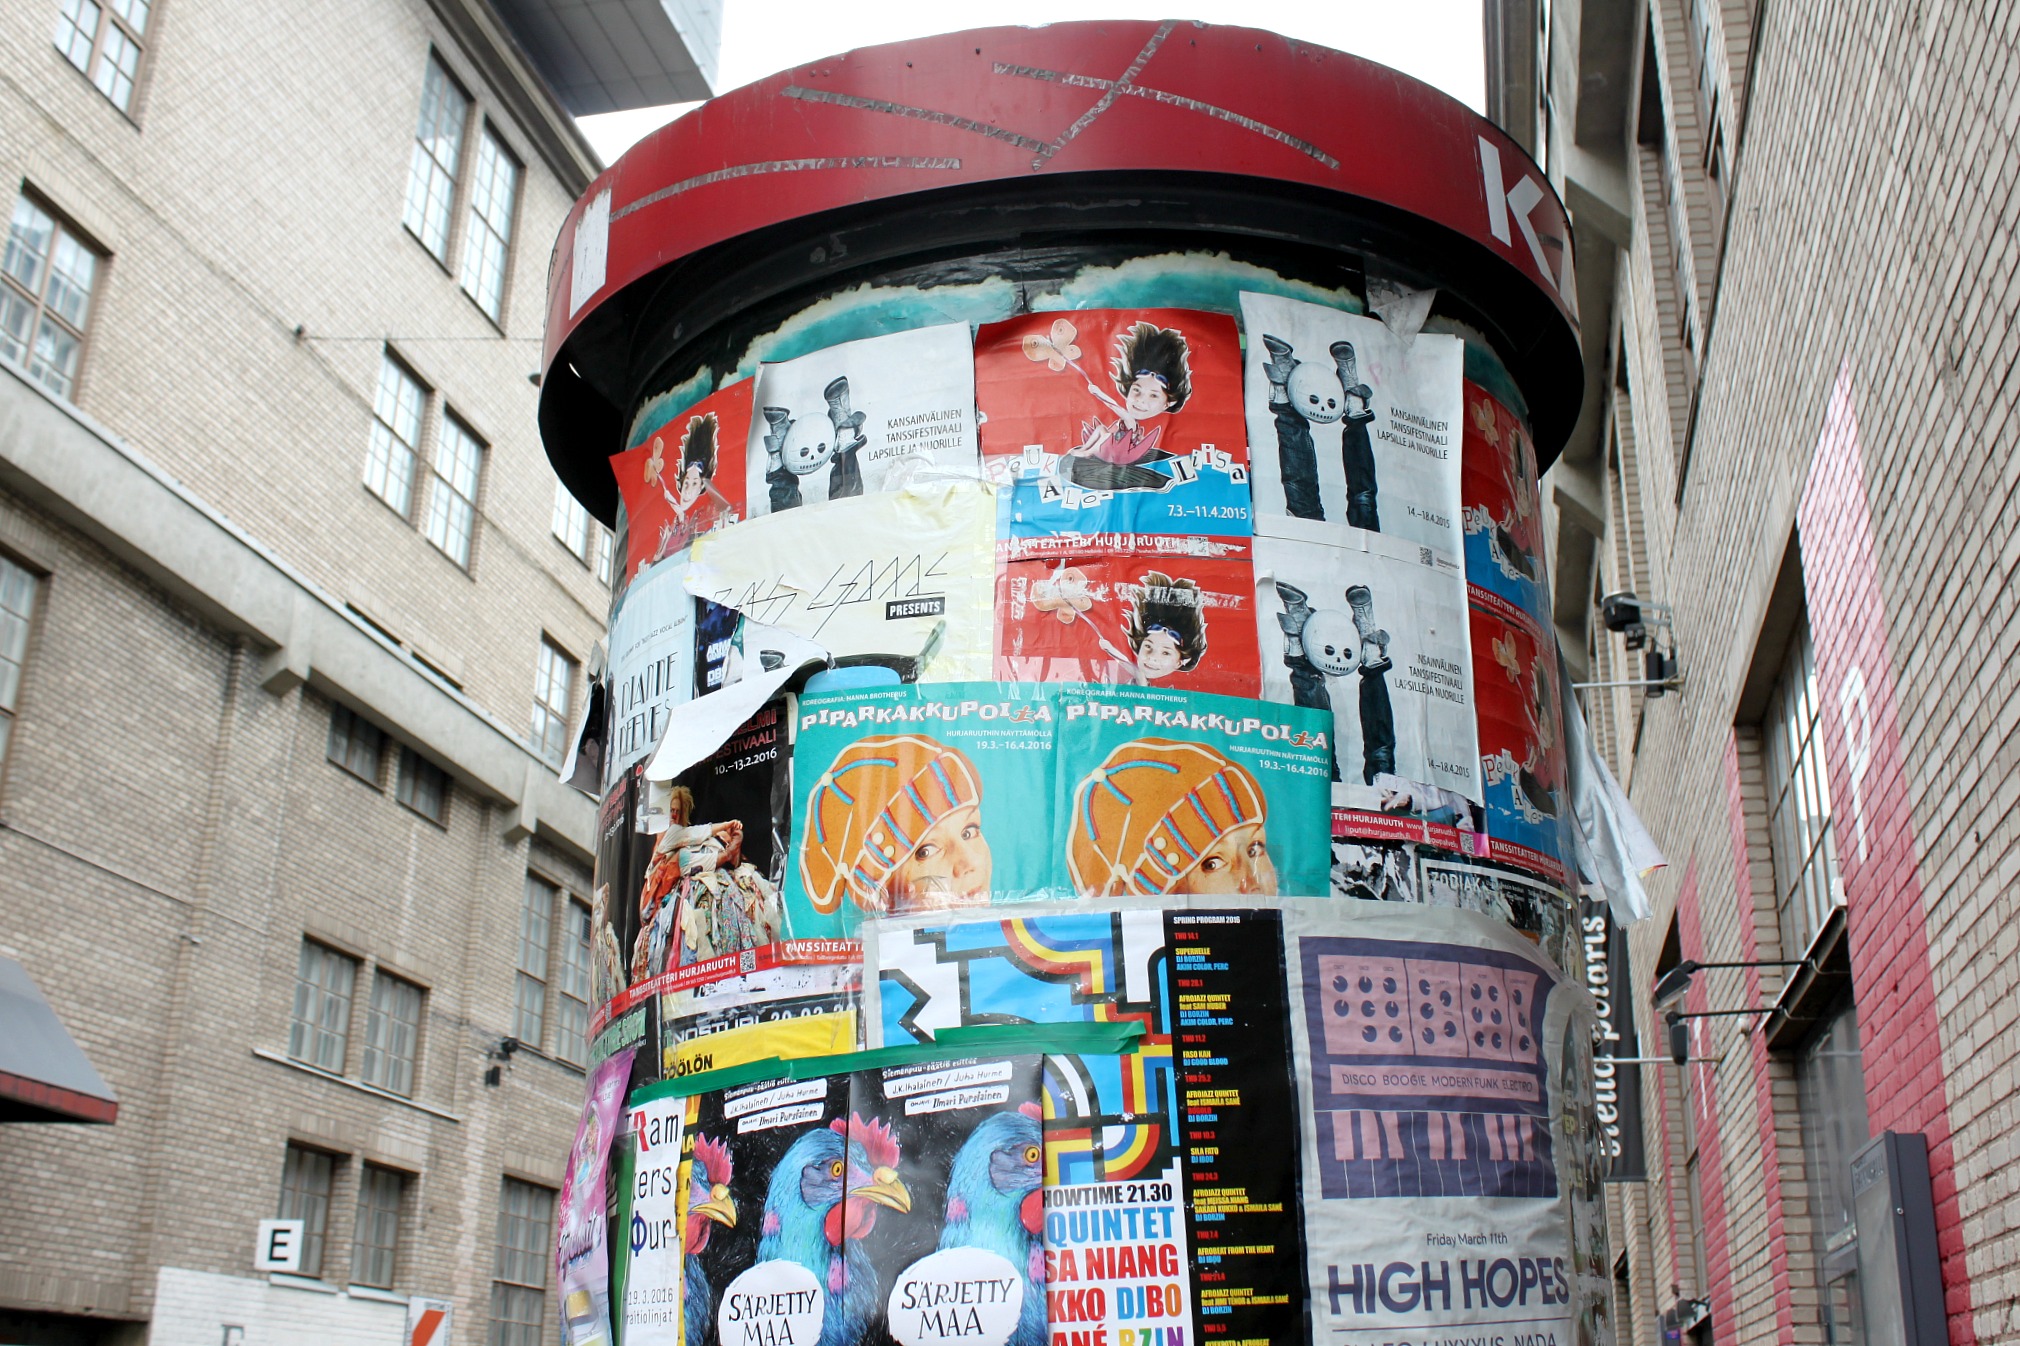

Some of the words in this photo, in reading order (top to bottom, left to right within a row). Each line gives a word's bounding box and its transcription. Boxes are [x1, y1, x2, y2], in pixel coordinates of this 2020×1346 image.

[888, 409, 962, 429] KANSAINVÄLINEN
[1390, 407, 1448, 431] KANSAINVÄLINEN
[886, 423, 962, 443] TANSSIFESTIVAALI
[1390, 420, 1448, 445] TANSSIFESTIVAALI
[868, 445, 906, 461] LAPSILLE
[908, 444, 917, 454] JA
[920, 437, 962, 452] NUORILLE
[1377, 429, 1407, 447] LAPSILLE
[1408, 440, 1416, 450] JA
[1416, 443, 1448, 459] NUORILLE
[889, 600, 940, 617] PRESENTS
[1467, 585, 1515, 616] TANSSITEATTERI
[1409, 666, 1463, 690] TANSSIFESTIVAALI
[846, 693, 869, 702] HANNA
[870, 690, 907, 700] BROTHERUS
[1119, 691, 1145, 700] HANNA
[1146, 693, 1188, 704] BROTHERUS
[1435, 688, 1464, 704] NUORILLE
[946, 729, 1000, 738] HURJARUUTHIN
[1000, 728, 1052, 738] NÄYTTÄMÖLLÄ
[1229, 744, 1281, 758] HURJARUUTHIN
[1281, 752, 1328, 765] NÄYTTÄMÖLLÄ
[1353, 815, 1404, 827] HURJARUUTH
[1490, 840, 1539, 861] TANSSITEATTERI
[1173, 916, 1196, 924] SPRING
[1196, 916, 1226, 924] PROGRAM
[1176, 955, 1184, 963] DJ
[629, 972, 678, 998] TANSSITEATTERI
[679, 956, 736, 979] HURJARUUTH
[1207, 994, 1231, 1002] QUINTET
[1180, 1010, 1188, 1018] DJ
[977, 1070, 1002, 1079] Hurme
[1341, 1073, 1377, 1086] DISCO
[1382, 1073, 1427, 1087] BOOGIE
[1431, 1075, 1473, 1088] MODERN
[1474, 1077, 1499, 1089] FUNK
[1502, 1079, 1533, 1093] ELECTRO
[932, 1095, 957, 1109] Ilmari
[1186, 1090, 1214, 1098] AFROJAZZ
[1214, 1089, 1239, 1097] QUINTET
[759, 1113, 778, 1127] Ilmari
[1187, 1114, 1196, 1123] DJ
[1127, 1183, 1172, 1204] 21.30
[1221, 1188, 1246, 1196] QUINTET
[1195, 1213, 1203, 1222] DJ
[1046, 1206, 1175, 1248] QUINTET
[268, 1229, 291, 1262] E
[1426, 1232, 1456, 1248] Friday
[1457, 1232, 1487, 1245] March
[1489, 1231, 1508, 1245] 11th
[1227, 1246, 1245, 1255] FROM
[1245, 1245, 1256, 1254] THE
[1256, 1245, 1275, 1254] HEART
[1045, 1249, 1079, 1283] SA
[1085, 1243, 1179, 1281] NIANG
[1198, 1255, 1206, 1264] DJ
[901, 1278, 1015, 1310] SÄRJETTY
[1229, 1288, 1254, 1296] QUINTET
[1327, 1260, 1451, 1315] HIGH
[1460, 1256, 1570, 1310] HOPES
[728, 1289, 818, 1322] SÄRJETTY
[1202, 1306, 1210, 1315] DJ
[918, 1306, 985, 1339] MAA
[743, 1317, 795, 1346] MAA
